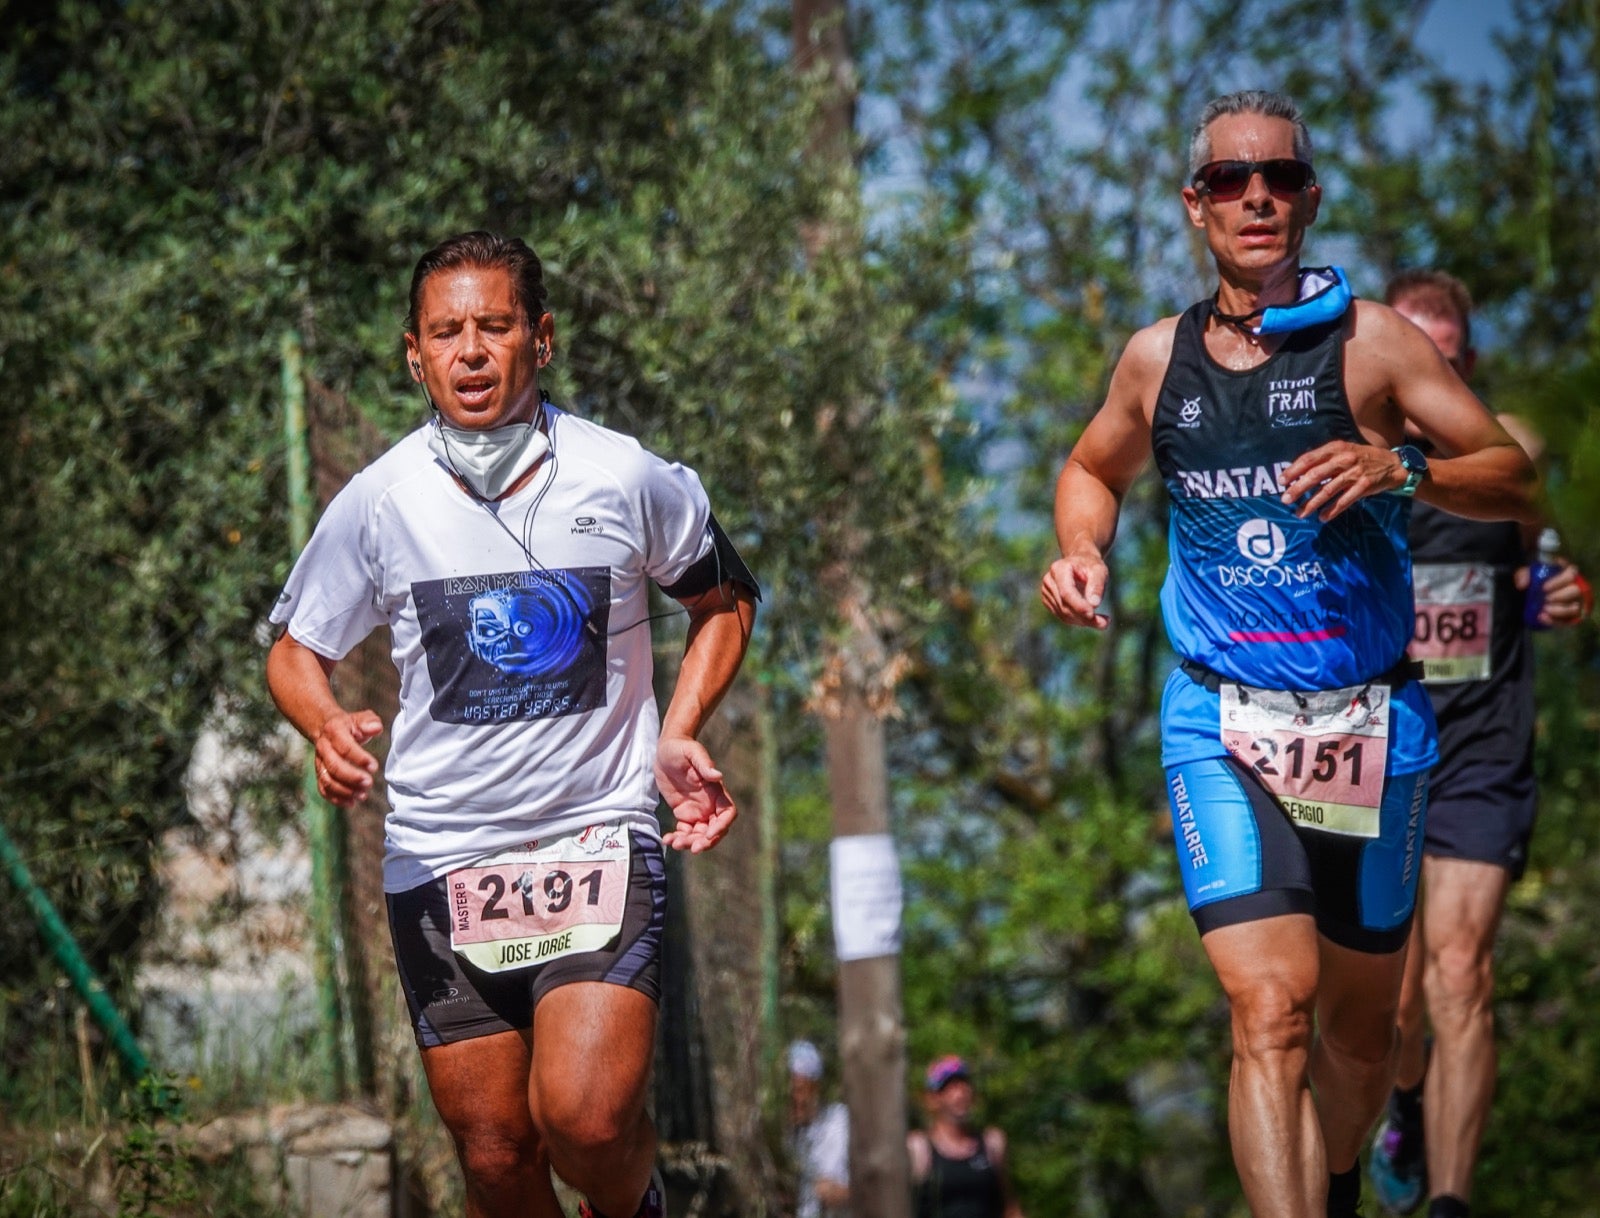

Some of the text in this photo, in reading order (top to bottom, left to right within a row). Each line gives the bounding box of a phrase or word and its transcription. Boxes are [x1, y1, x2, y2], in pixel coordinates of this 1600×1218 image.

[1269, 376, 1316, 391] TATTOO
[1268, 390, 1317, 418] FRAN
[1271, 412, 1313, 429] Studio
[1177, 461, 1332, 498] TRIATA
[444, 569, 568, 596] IRON MAIDEN
[1218, 561, 1327, 587] DISCONFA
[1228, 604, 1343, 629] MONTALVO
[1414, 609, 1478, 644] 068
[464, 703, 519, 720] WASTED
[1251, 737, 1363, 786] 2151
[1172, 772, 1209, 871] TRIATARFE
[1281, 801, 1324, 824] SERGIO
[1402, 772, 1427, 886] TRIATARFE
[455, 882, 470, 931] MASTER B
[478, 869, 604, 922] 2191
[500, 931, 573, 965] JOSE JORGE
